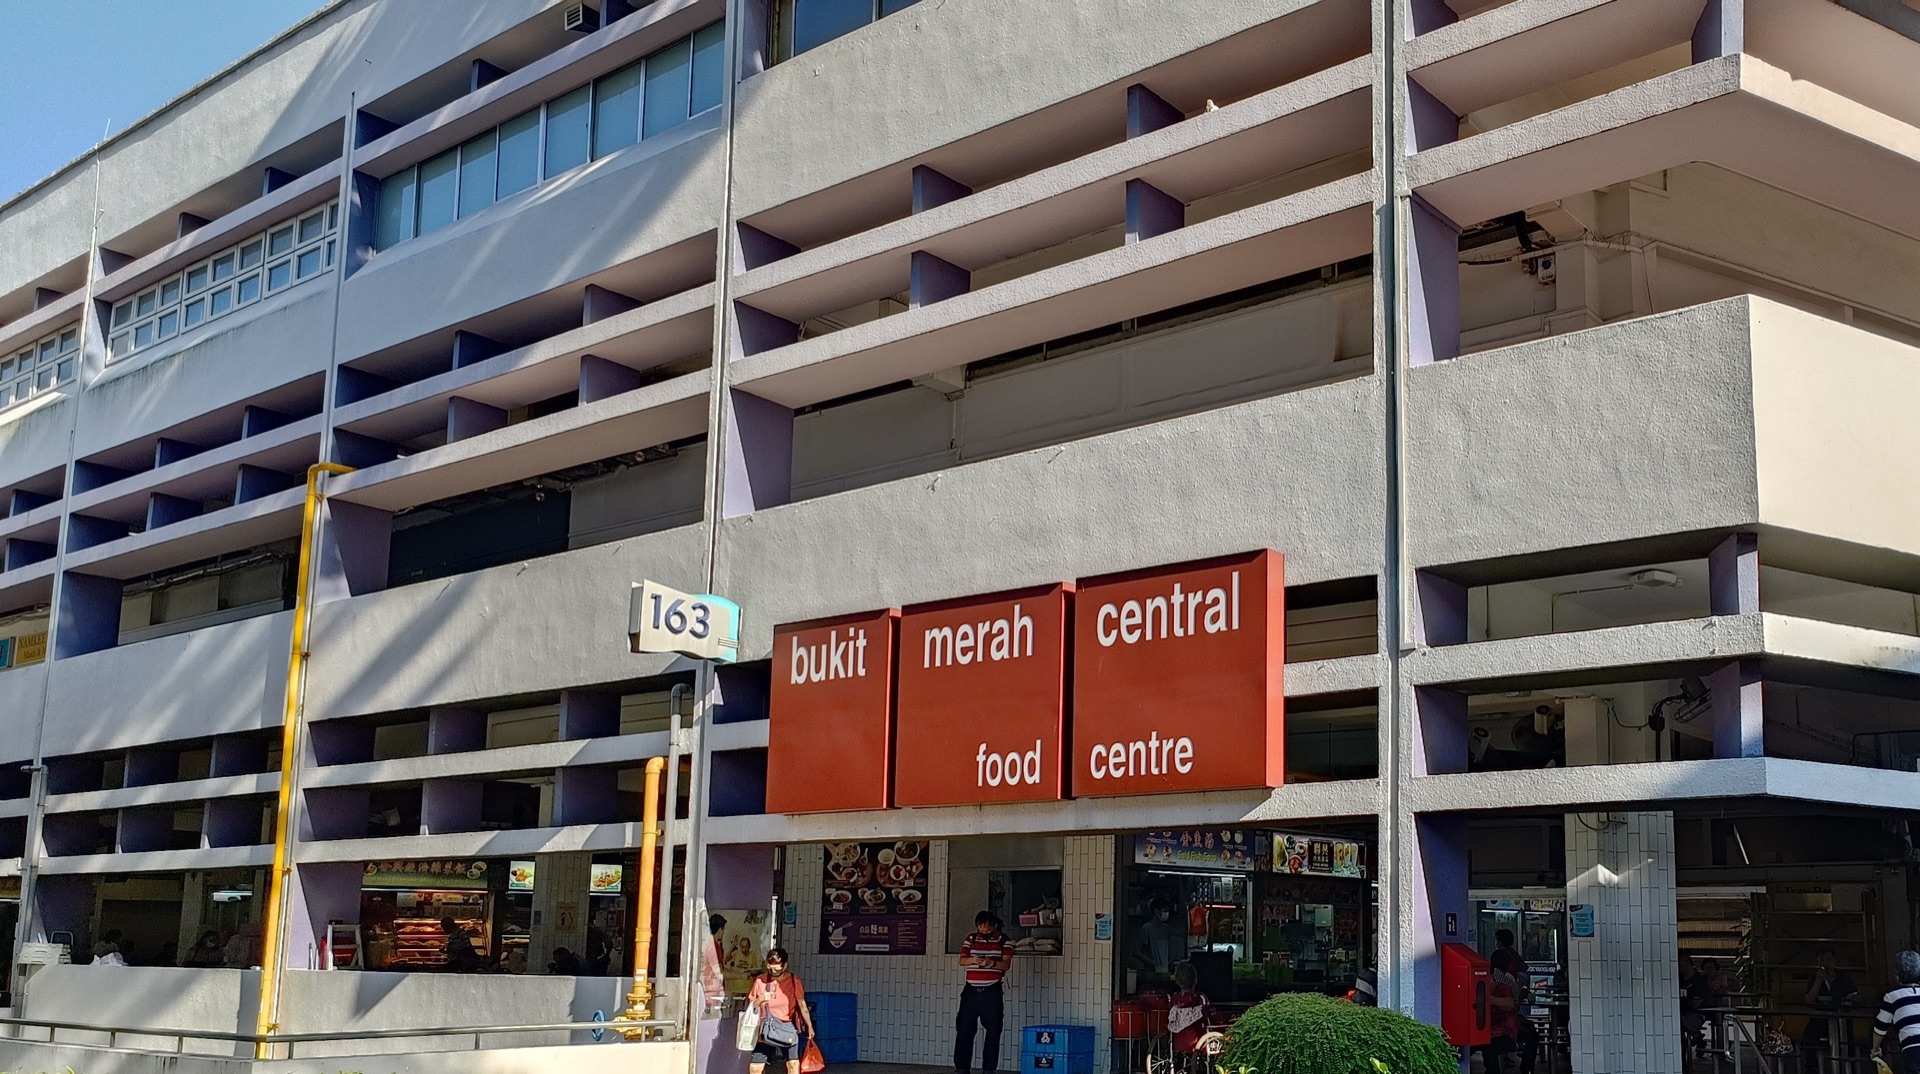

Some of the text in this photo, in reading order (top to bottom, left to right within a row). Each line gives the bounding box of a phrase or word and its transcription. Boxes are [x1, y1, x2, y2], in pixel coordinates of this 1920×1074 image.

[650, 593, 710, 639] 163
[790, 571, 1240, 685] bukit merah central
[976, 731, 1193, 787] food centre
[1178, 849, 1217, 863] Gold Fish Soup
[743, 914, 764, 925] After
